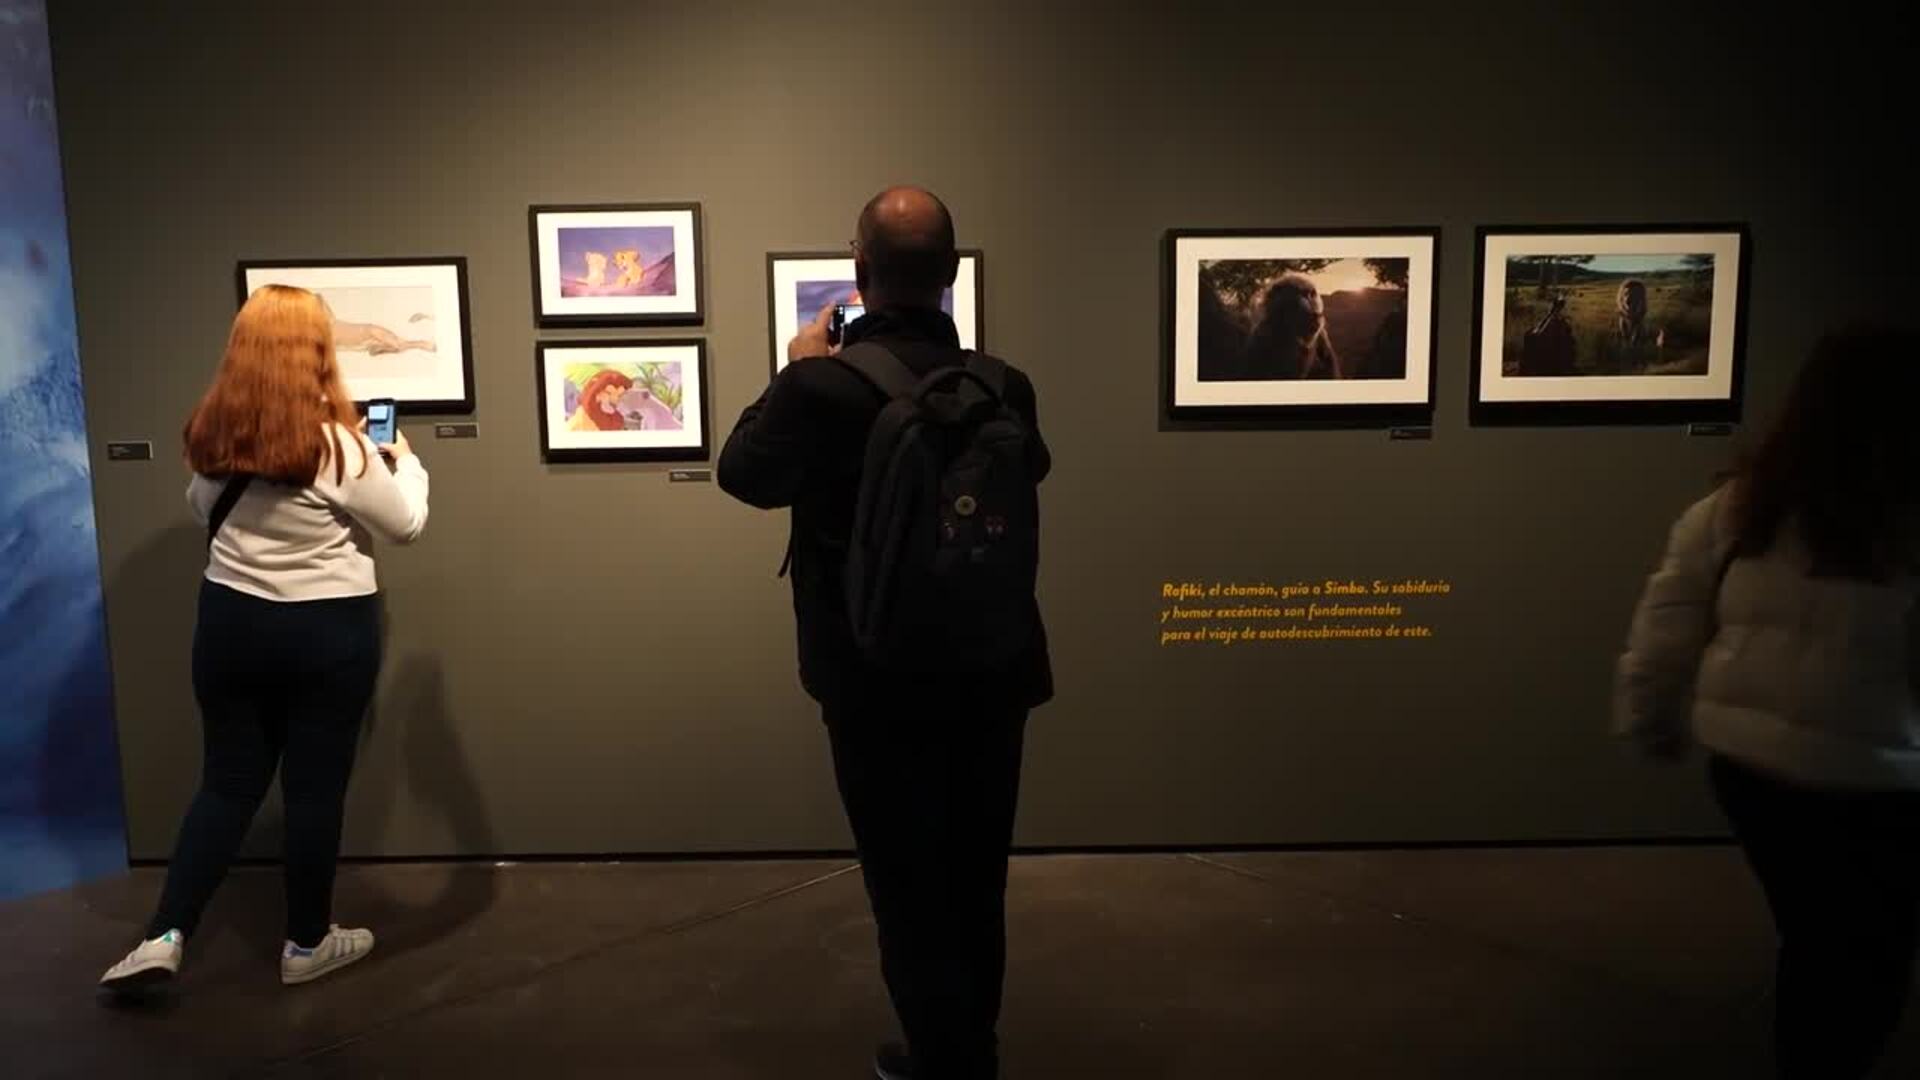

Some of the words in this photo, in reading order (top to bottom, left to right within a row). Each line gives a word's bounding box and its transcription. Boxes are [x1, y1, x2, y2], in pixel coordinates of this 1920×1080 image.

[1162, 582, 1206, 601] Rafiki,
[1209, 582, 1221, 596] el
[1223, 582, 1279, 597] chamón,
[1281, 582, 1309, 599] guía
[1312, 586, 1321, 595] a
[1324, 580, 1369, 594] Simba.
[1372, 580, 1390, 593] Su
[1391, 579, 1450, 593] sabiduría
[1160, 609, 1170, 623] y
[1172, 605, 1214, 619] humor
[1216, 604, 1281, 618] excéntrico
[1284, 609, 1305, 617] son
[1307, 602, 1402, 621] fundamentales
[1161, 630, 1191, 646] para
[1194, 626, 1206, 640] el
[1209, 626, 1238, 644] viaje
[1241, 626, 1256, 640] de
[1259, 624, 1382, 639] autodescubrimiento
[1385, 624, 1400, 637] de
[1403, 625, 1432, 637] este.
